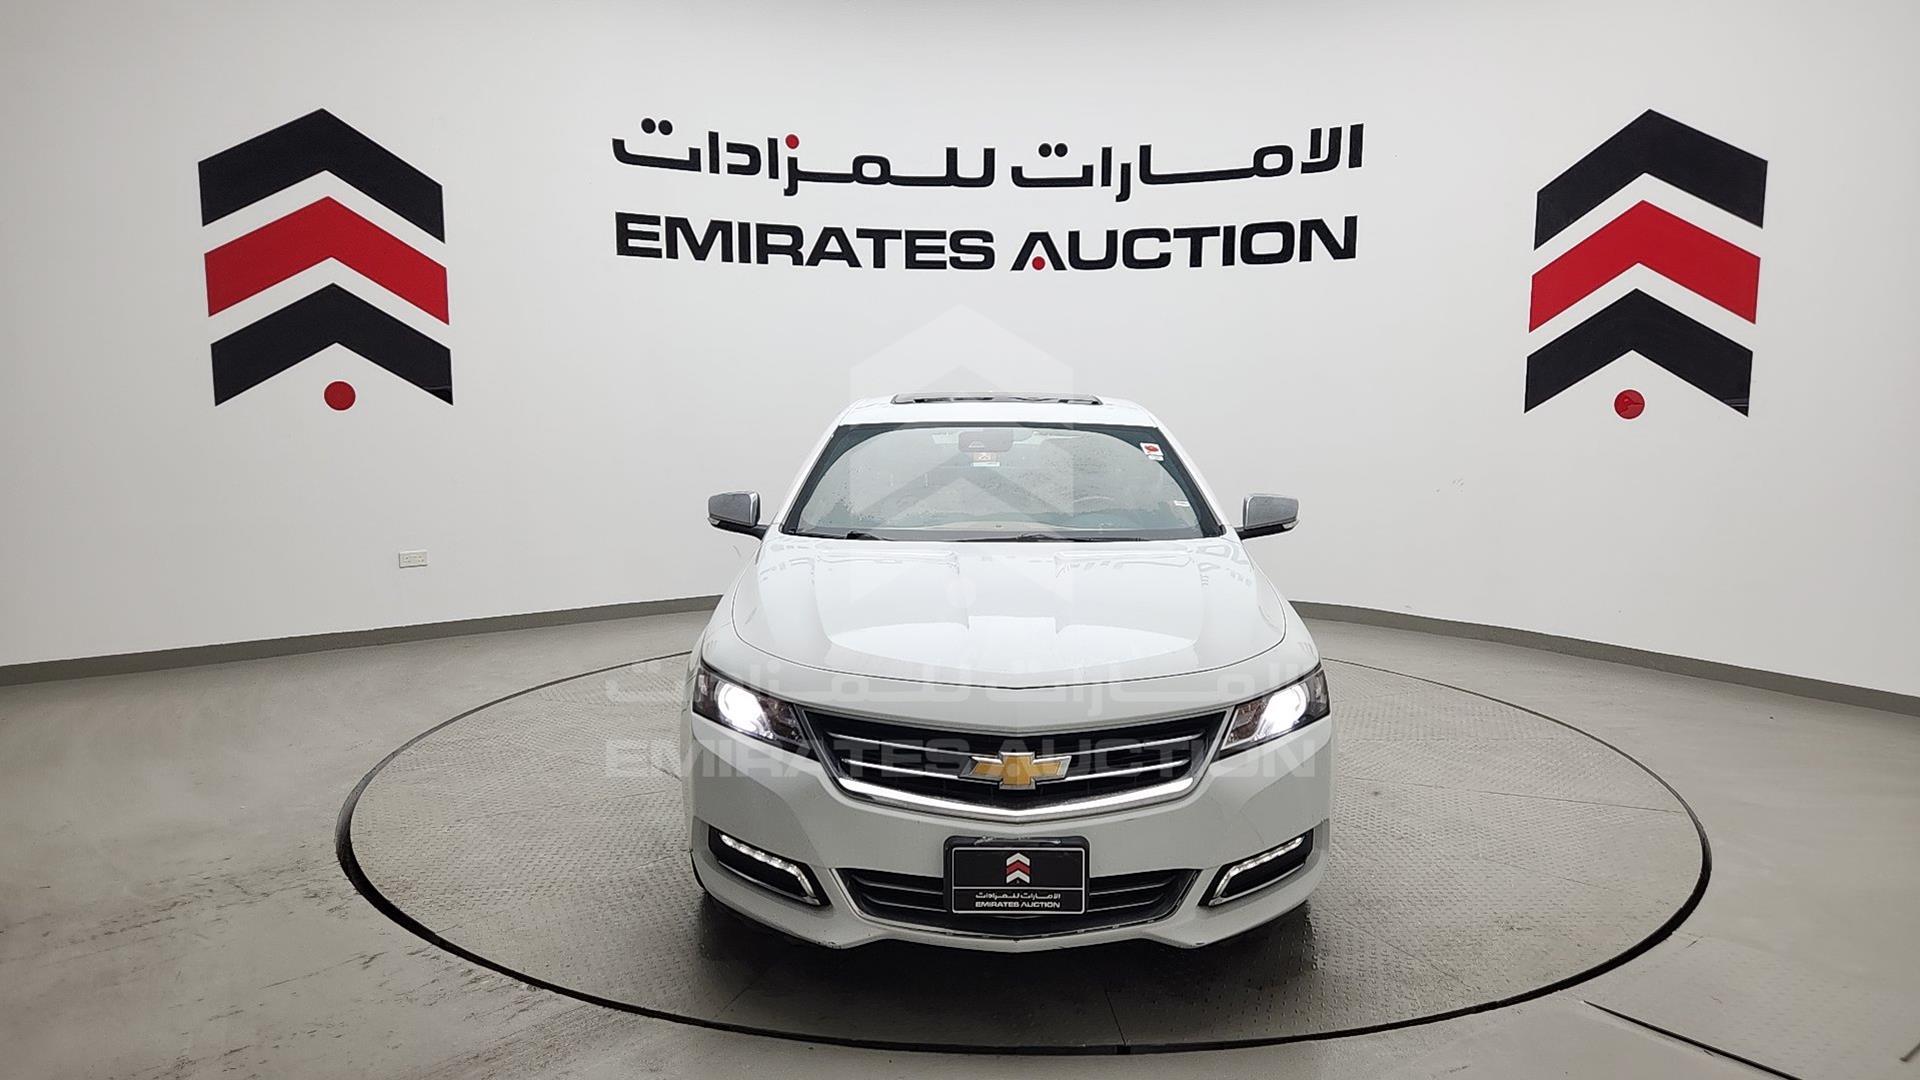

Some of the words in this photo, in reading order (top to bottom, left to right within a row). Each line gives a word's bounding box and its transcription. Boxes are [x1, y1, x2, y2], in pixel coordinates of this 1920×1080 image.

[611, 117, 996, 197] للمزادات
[1010, 122, 1364, 203] الامارات
[616, 211, 996, 271] EMIRATES
[1010, 215, 1358, 272] AUCTION
[1020, 901, 1061, 909] AUCTION
